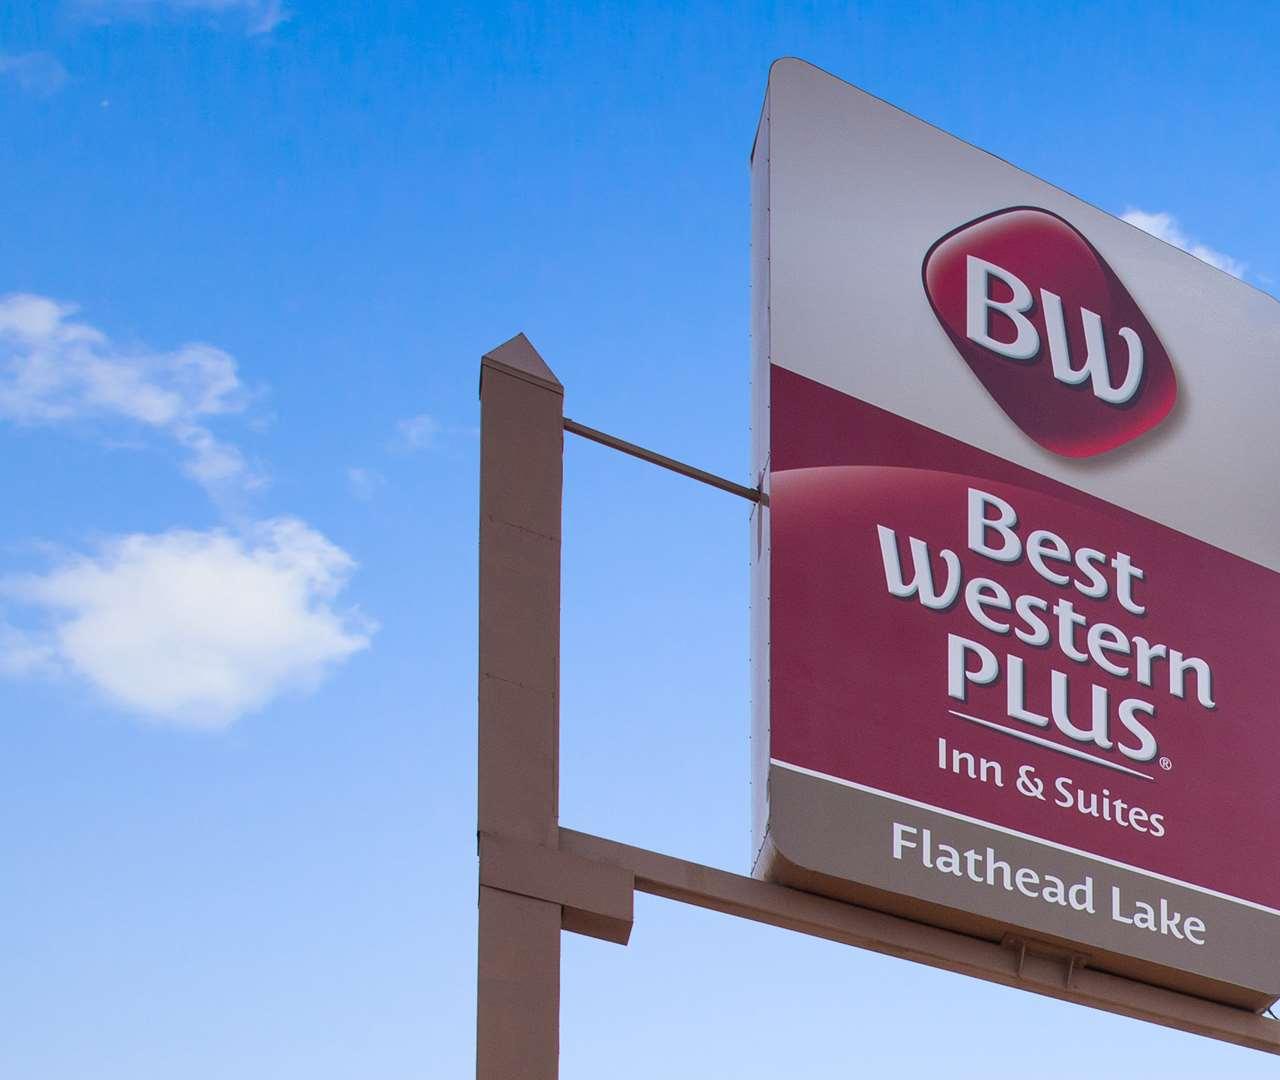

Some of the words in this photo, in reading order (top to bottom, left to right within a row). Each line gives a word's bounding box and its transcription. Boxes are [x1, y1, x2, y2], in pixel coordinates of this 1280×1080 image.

[967, 255, 1144, 404] BW
[968, 487, 1145, 614] Best
[877, 524, 1215, 708] Western
[938, 737, 1003, 787] Inn
[1016, 765, 1046, 801] &
[1054, 777, 1165, 837] Suites
[893, 822, 1095, 914] Flathead
[1111, 886, 1206, 945] Lake
